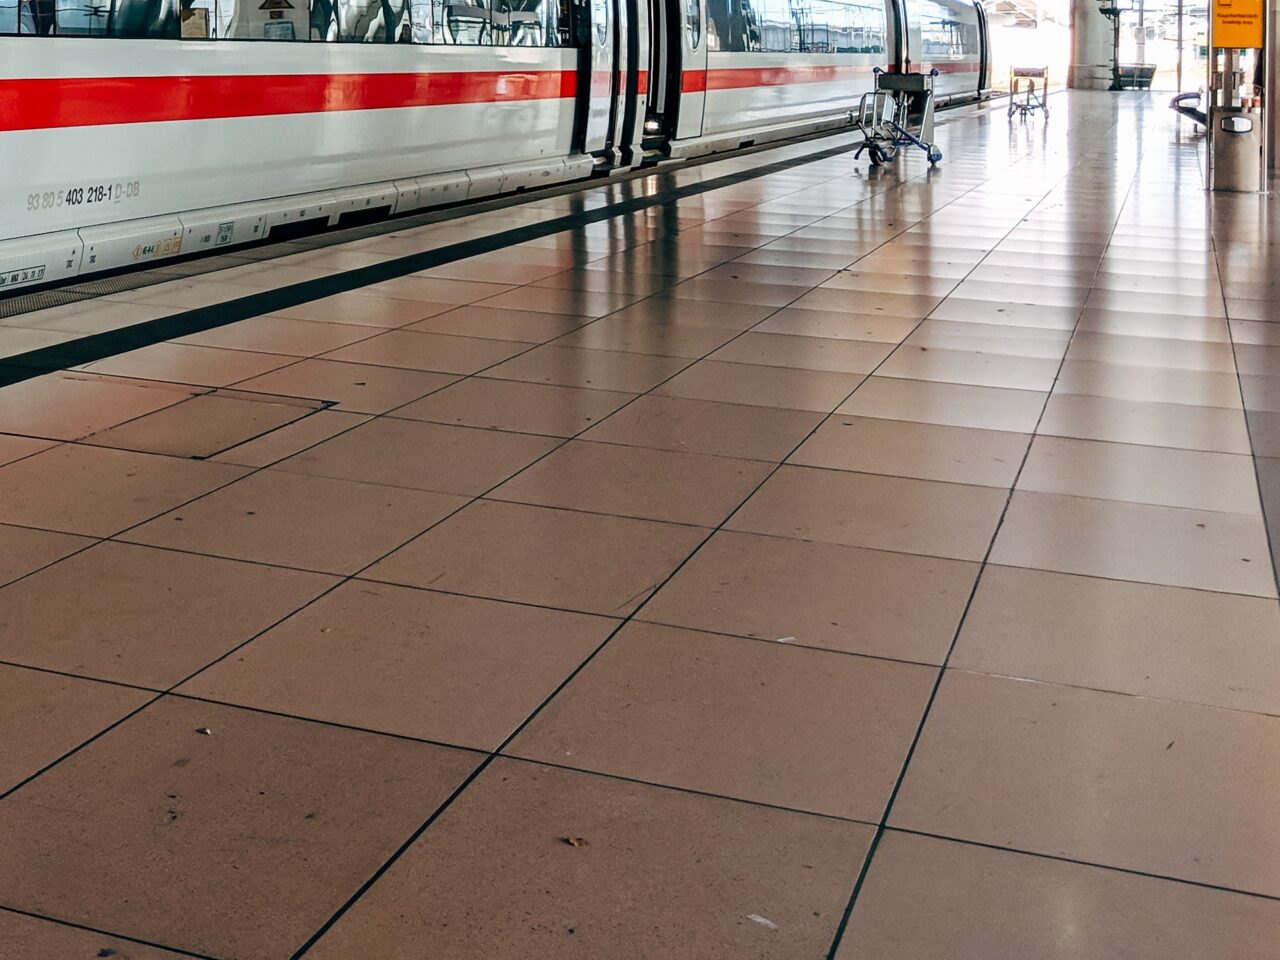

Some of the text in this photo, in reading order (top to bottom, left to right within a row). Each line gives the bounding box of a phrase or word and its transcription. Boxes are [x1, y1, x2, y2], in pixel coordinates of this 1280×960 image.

[26, 194, 39, 211] 93
[41, 192, 55, 210] 80
[65, 188, 83, 205] 403
[86, 184, 113, 203] 218-1
[113, 181, 140, 203] D-DB
